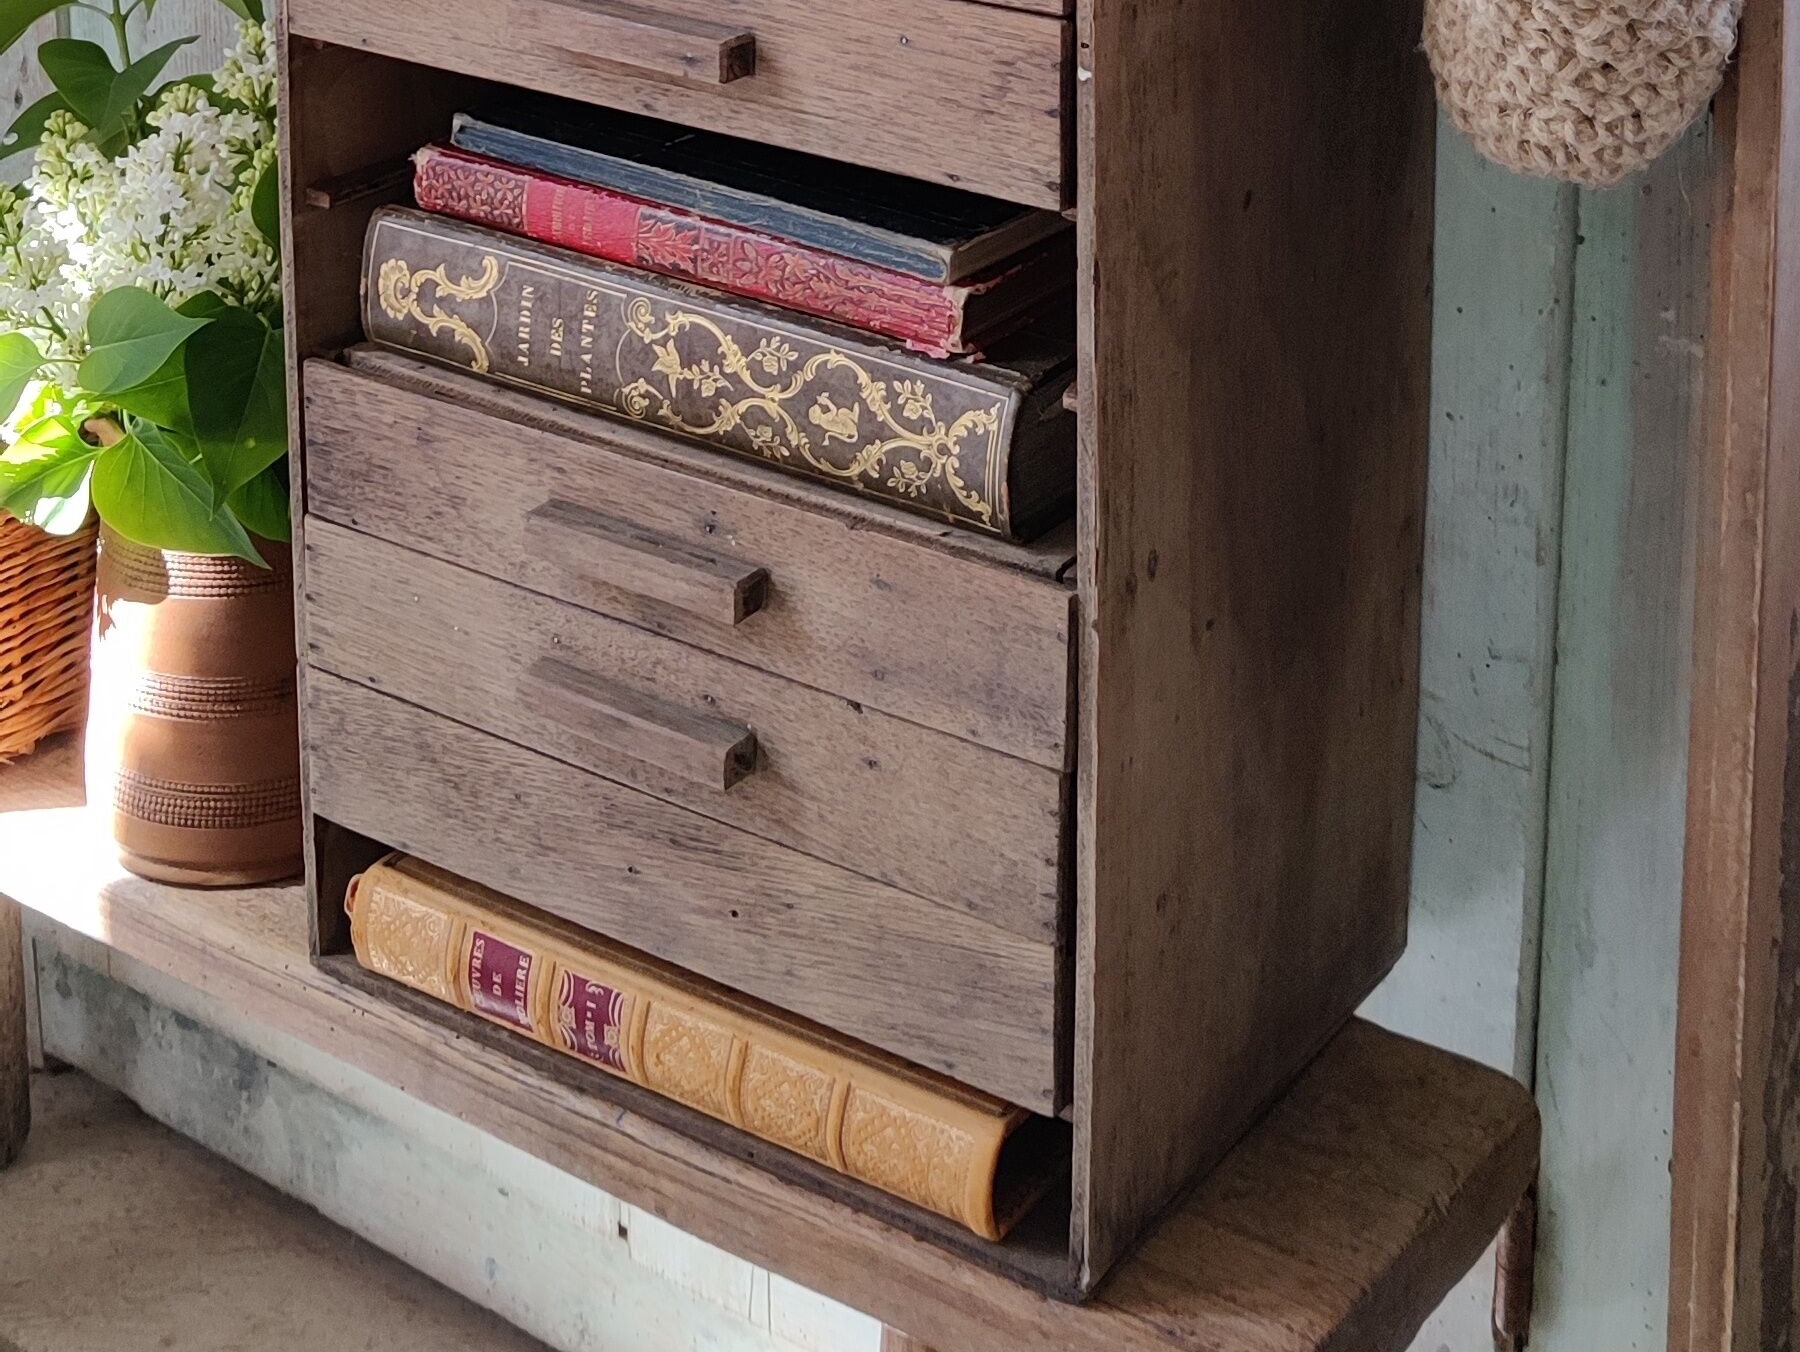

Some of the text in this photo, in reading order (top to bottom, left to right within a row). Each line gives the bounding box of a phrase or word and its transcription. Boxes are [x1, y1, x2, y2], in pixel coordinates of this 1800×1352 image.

[516, 284, 535, 367] JARDIN
[549, 317, 564, 357] DES
[579, 289, 599, 395] PLANTES
[492, 972, 502, 998] DE
